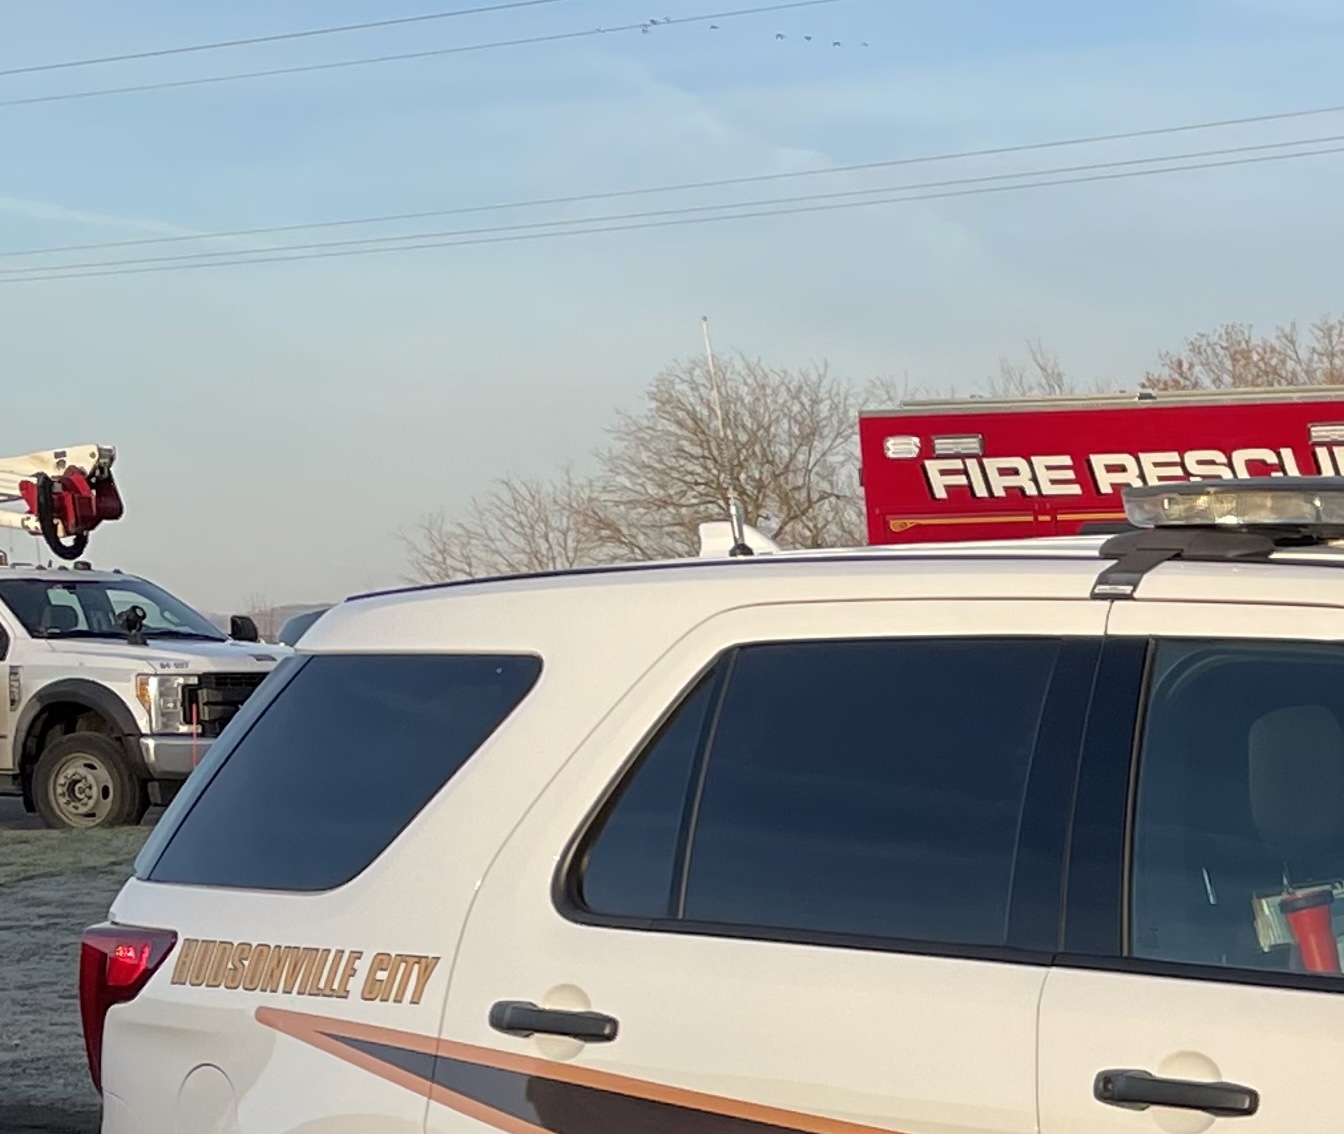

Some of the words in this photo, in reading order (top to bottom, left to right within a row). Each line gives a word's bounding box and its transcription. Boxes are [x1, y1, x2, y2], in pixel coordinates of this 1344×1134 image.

[923, 455, 1083, 499] FIRE
[171, 938, 363, 998] HUDSONVILLE
[361, 952, 441, 1004] CITY
